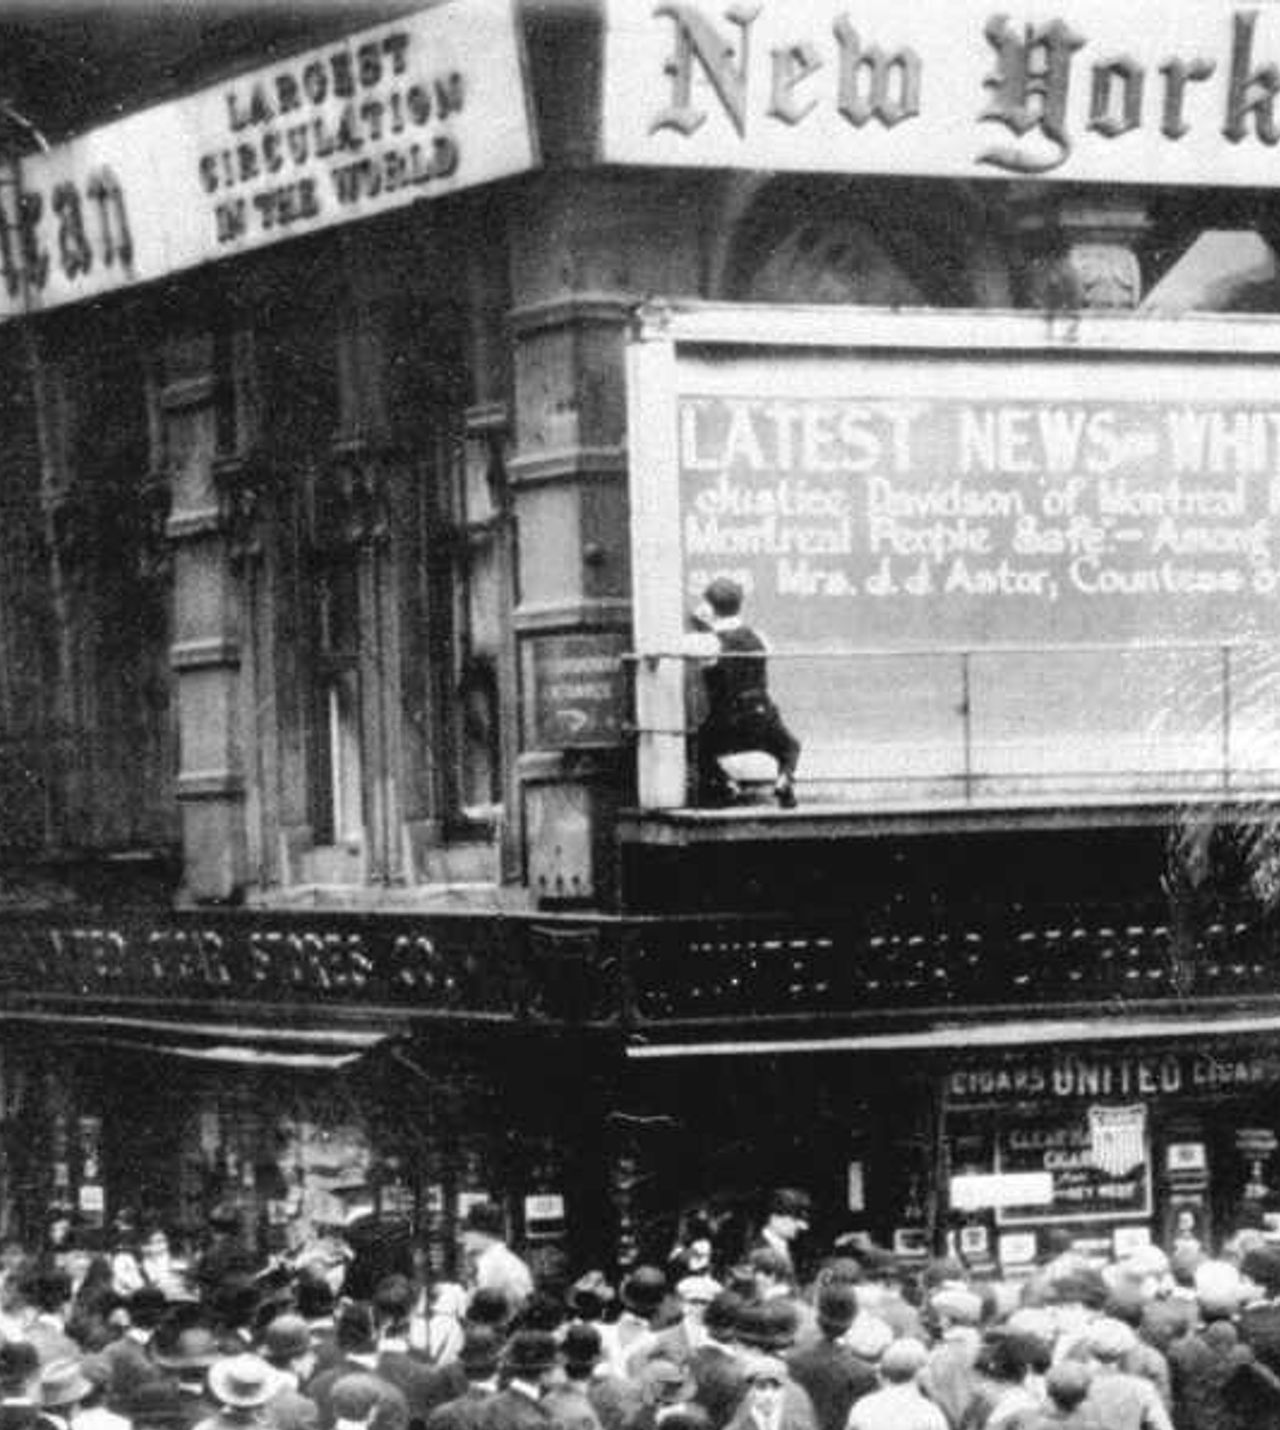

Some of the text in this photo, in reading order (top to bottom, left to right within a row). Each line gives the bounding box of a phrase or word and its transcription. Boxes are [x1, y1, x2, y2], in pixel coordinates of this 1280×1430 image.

[648, 2, 924, 142] New
[681, 402, 922, 471] LATEST
[1041, 476, 1086, 516] of
[1052, 1059, 1183, 1096] UNITED
